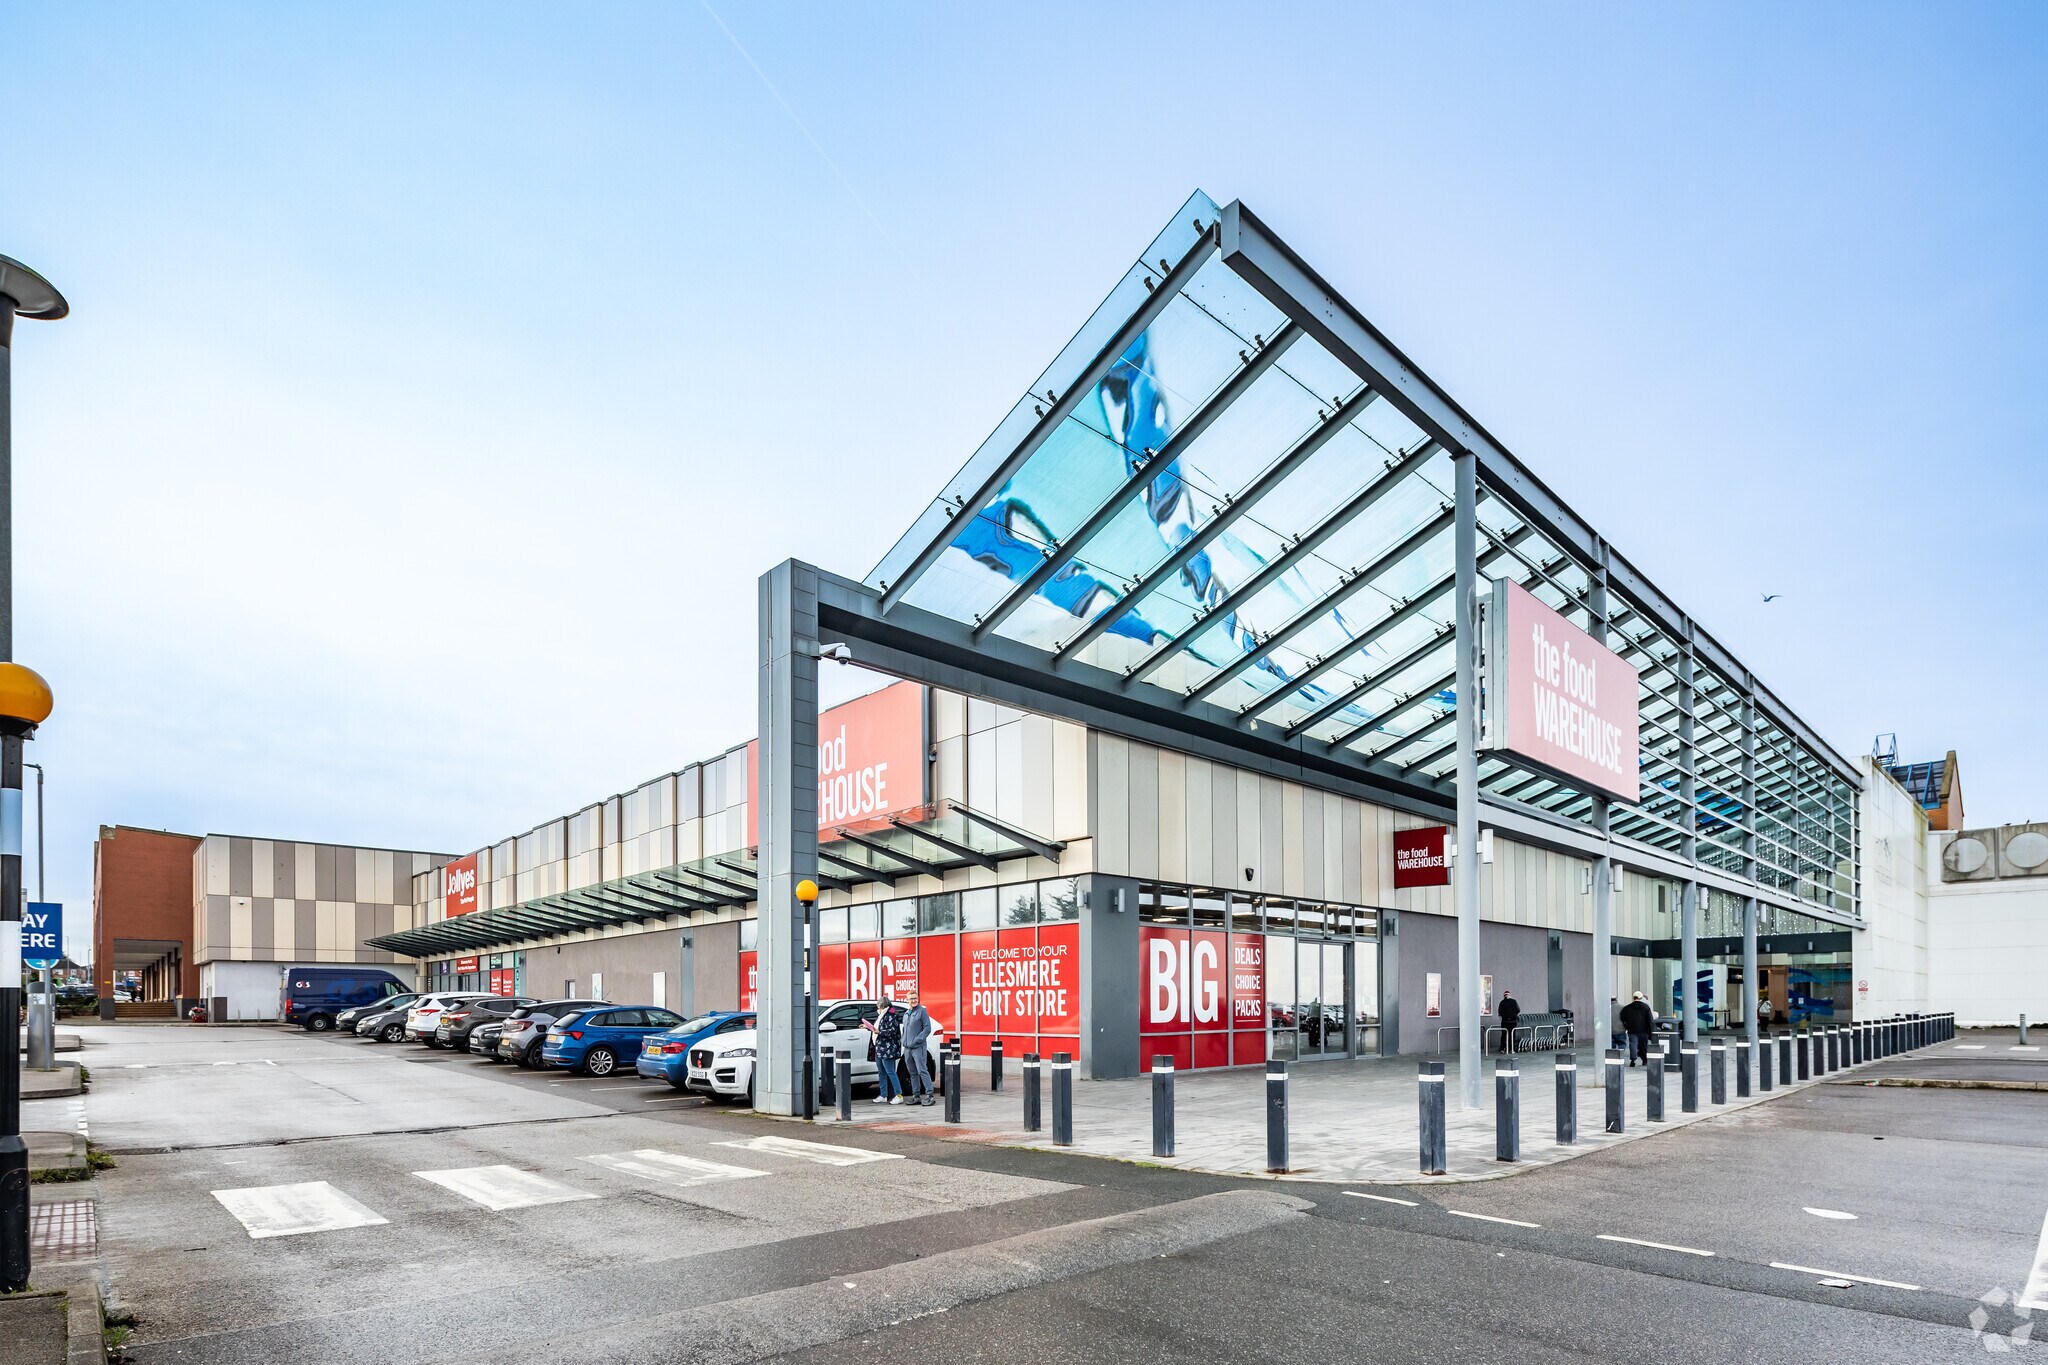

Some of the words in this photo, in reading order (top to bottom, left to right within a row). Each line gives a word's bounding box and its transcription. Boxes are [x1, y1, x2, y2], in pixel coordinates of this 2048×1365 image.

[1532, 623, 1560, 688] the
[1563, 641, 1596, 709] food
[1533, 682, 1622, 775] WAREHOUSE
[818, 724, 846, 777] od
[818, 762, 888, 825] HOUSE
[1397, 849, 1410, 860] the
[1411, 846, 1428, 858] food
[1397, 856, 1444, 870] WAREHOUSE
[447, 868, 475, 897] Jollyes
[21, 913, 48, 928] AY
[21, 932, 56, 948] ERE
[972, 948, 1020, 960] WELCOME
[1022, 946, 1036, 958] TO
[1037, 944, 1068, 957] YOUR
[1234, 947, 1261, 965] DEALS
[895, 958, 916, 973] DEALS
[972, 959, 1061, 988] ELLESMERE
[748, 965, 758, 989] th
[851, 955, 895, 1001] BIG
[895, 979, 916, 991] CHOICE
[1150, 938, 1218, 1023] BIG
[1235, 974, 1261, 990] CHOICE
[972, 990, 1012, 1016] PORT
[1015, 989, 1068, 1016] STORE
[1235, 999, 1261, 1017] PACKS
